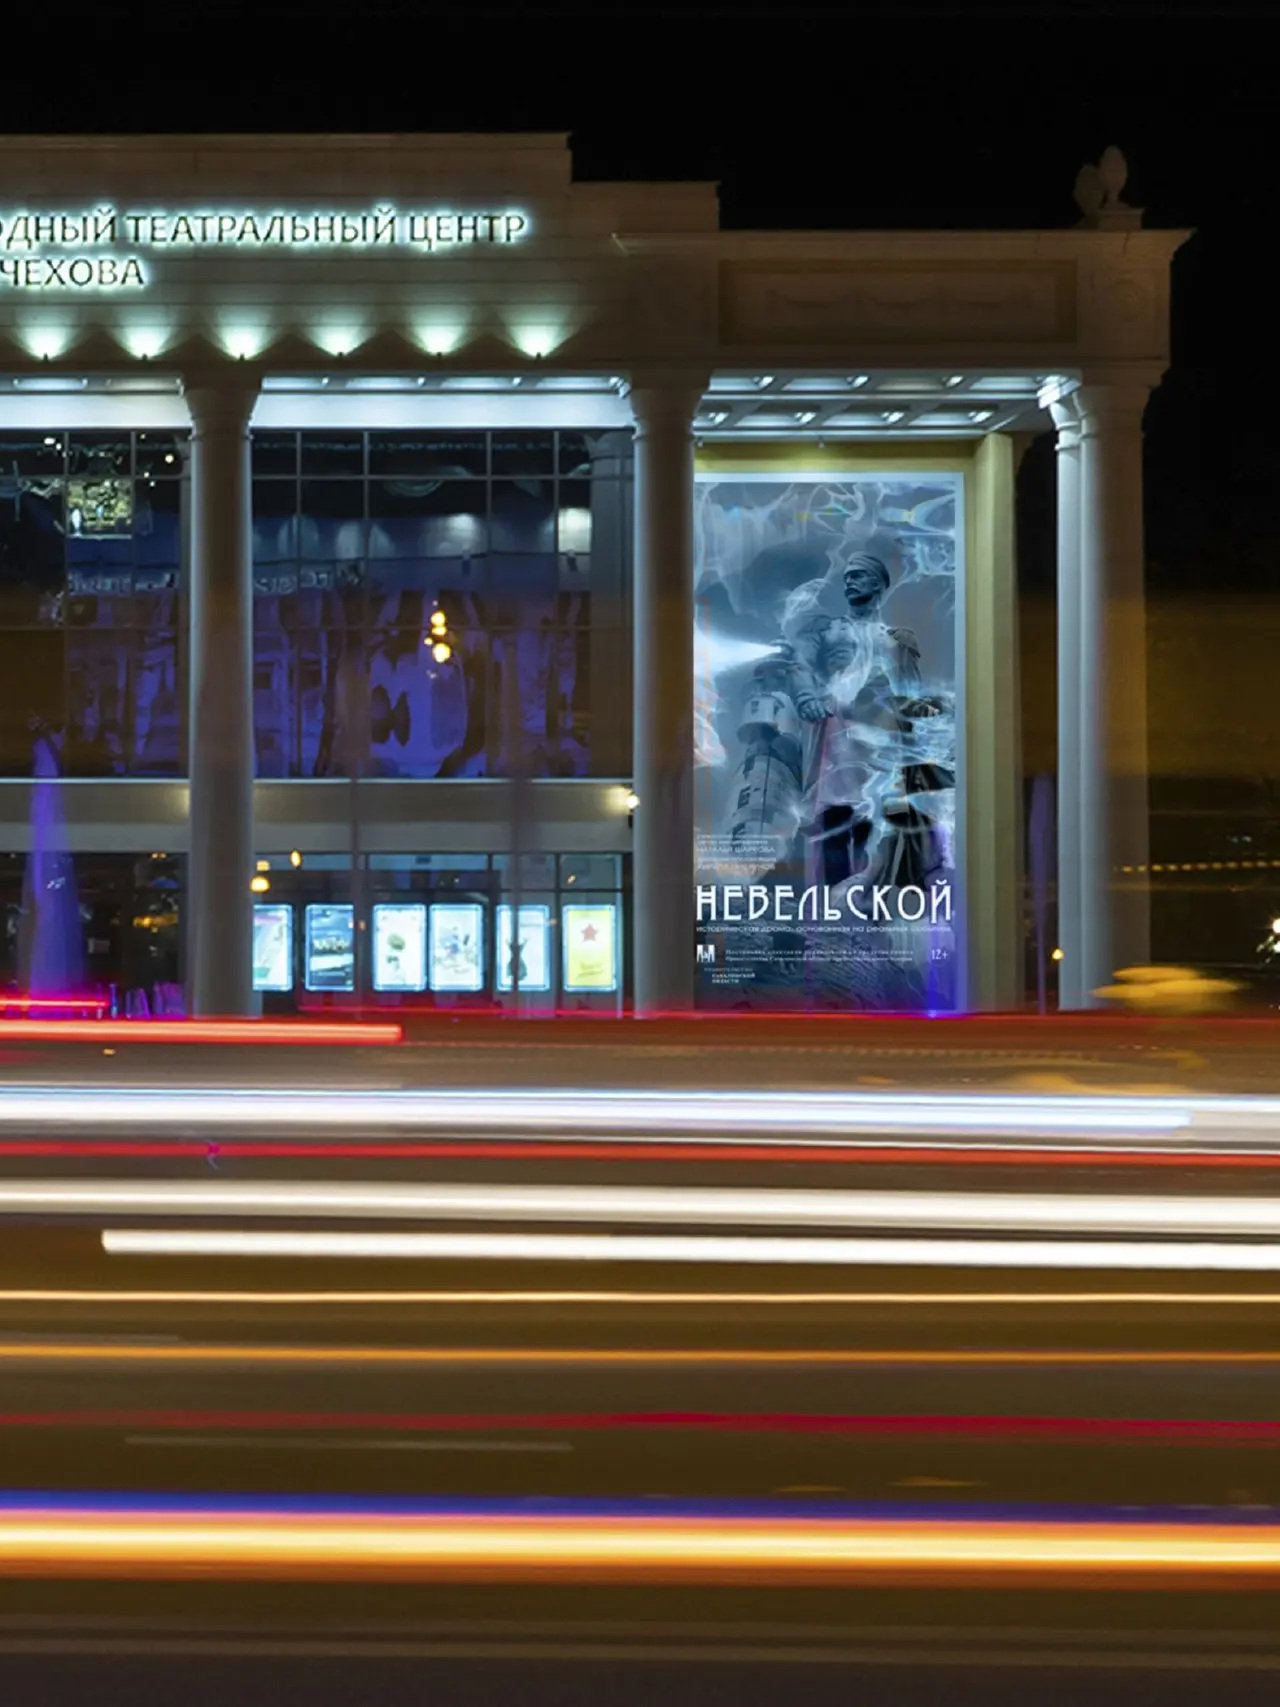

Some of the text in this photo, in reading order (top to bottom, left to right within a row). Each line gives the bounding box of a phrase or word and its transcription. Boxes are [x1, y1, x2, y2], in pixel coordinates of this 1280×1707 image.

[126, 207, 397, 244] ТЕАТРАЛЬНЫЙ
[409, 213, 526, 250] ЦЕНТР
[695, 878, 952, 924] НЕВЕЛЬСКОЙ
[930, 948, 949, 960] 12+
